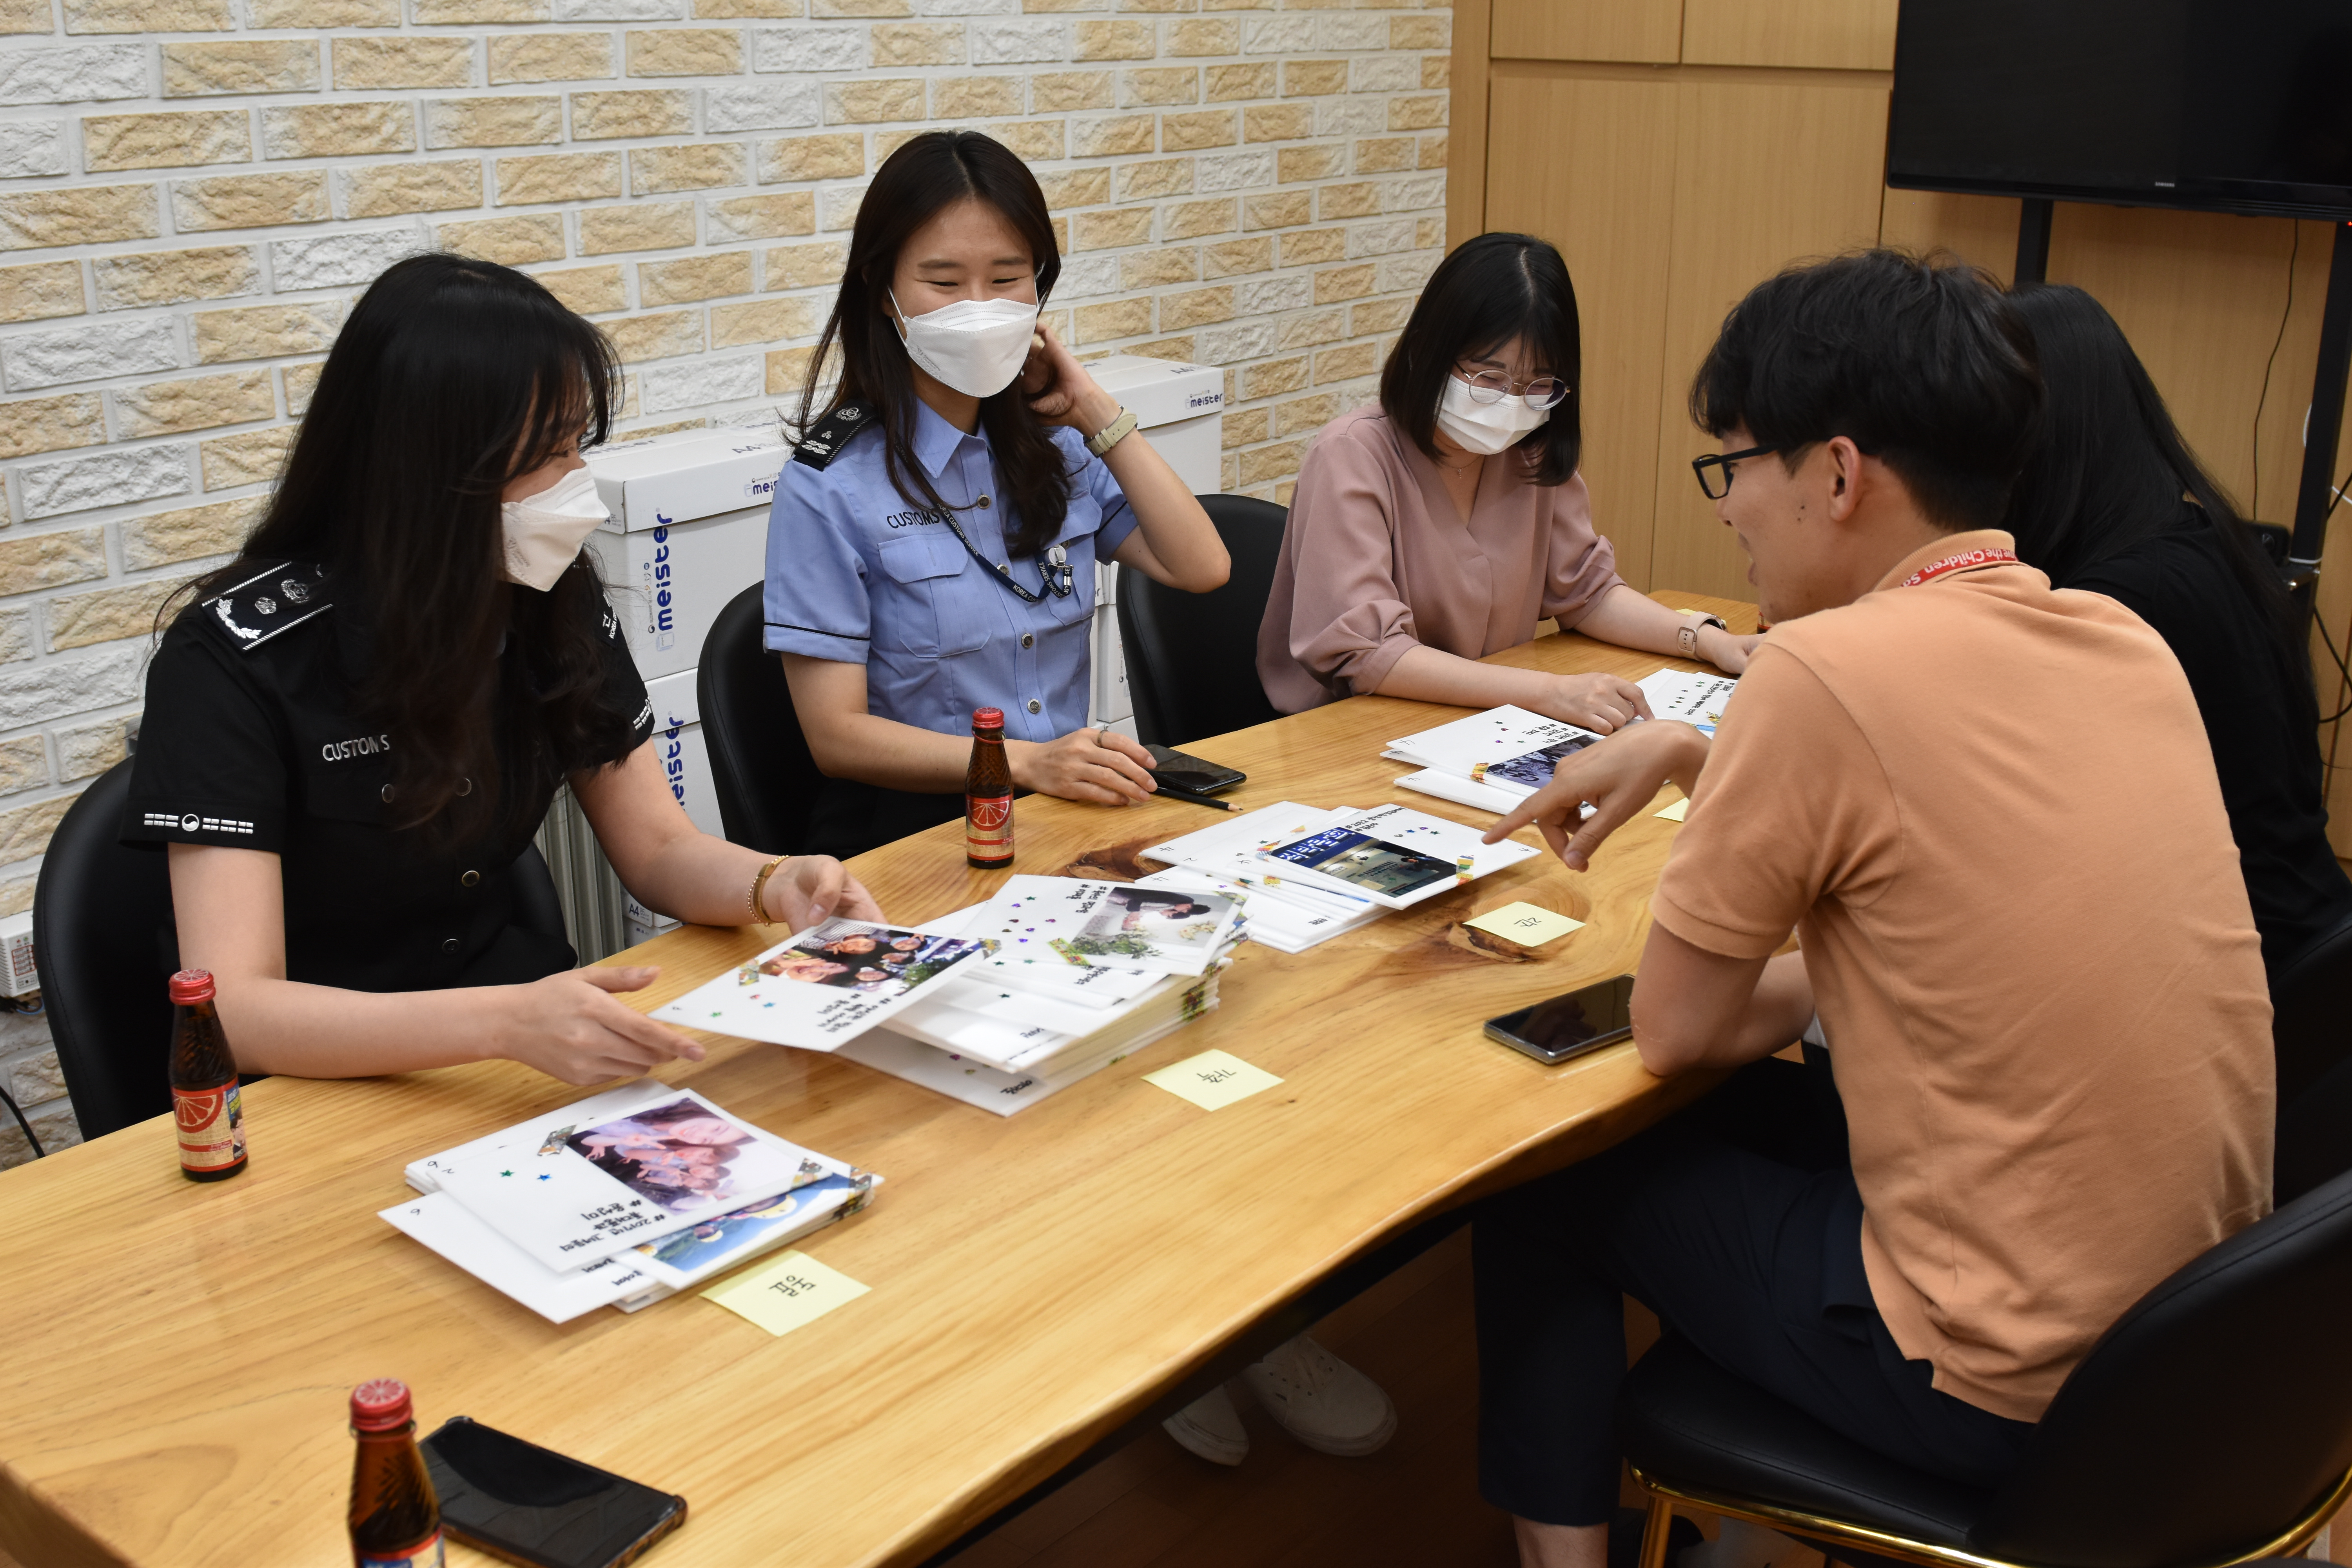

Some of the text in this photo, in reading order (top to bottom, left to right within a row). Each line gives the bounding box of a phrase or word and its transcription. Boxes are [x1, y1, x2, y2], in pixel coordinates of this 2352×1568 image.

[1191, 393, 1223, 408] meister
[887, 511, 940, 529] CUSTOMS
[949, 517, 965, 539] CUSTOMS
[964, 538, 979, 557] SERVICE
[1924, 550, 1985, 573] Children
[653, 513, 673, 631] meister
[1038, 561, 1051, 582] SERVICE
[1902, 573, 1921, 587] Sa
[1013, 584, 1029, 599] KOREA
[665, 716, 686, 811] eister
[629, 903, 639, 916] A4
[1197, 1070, 1236, 1083] 가족
[769, 1276, 816, 1297] 동료
